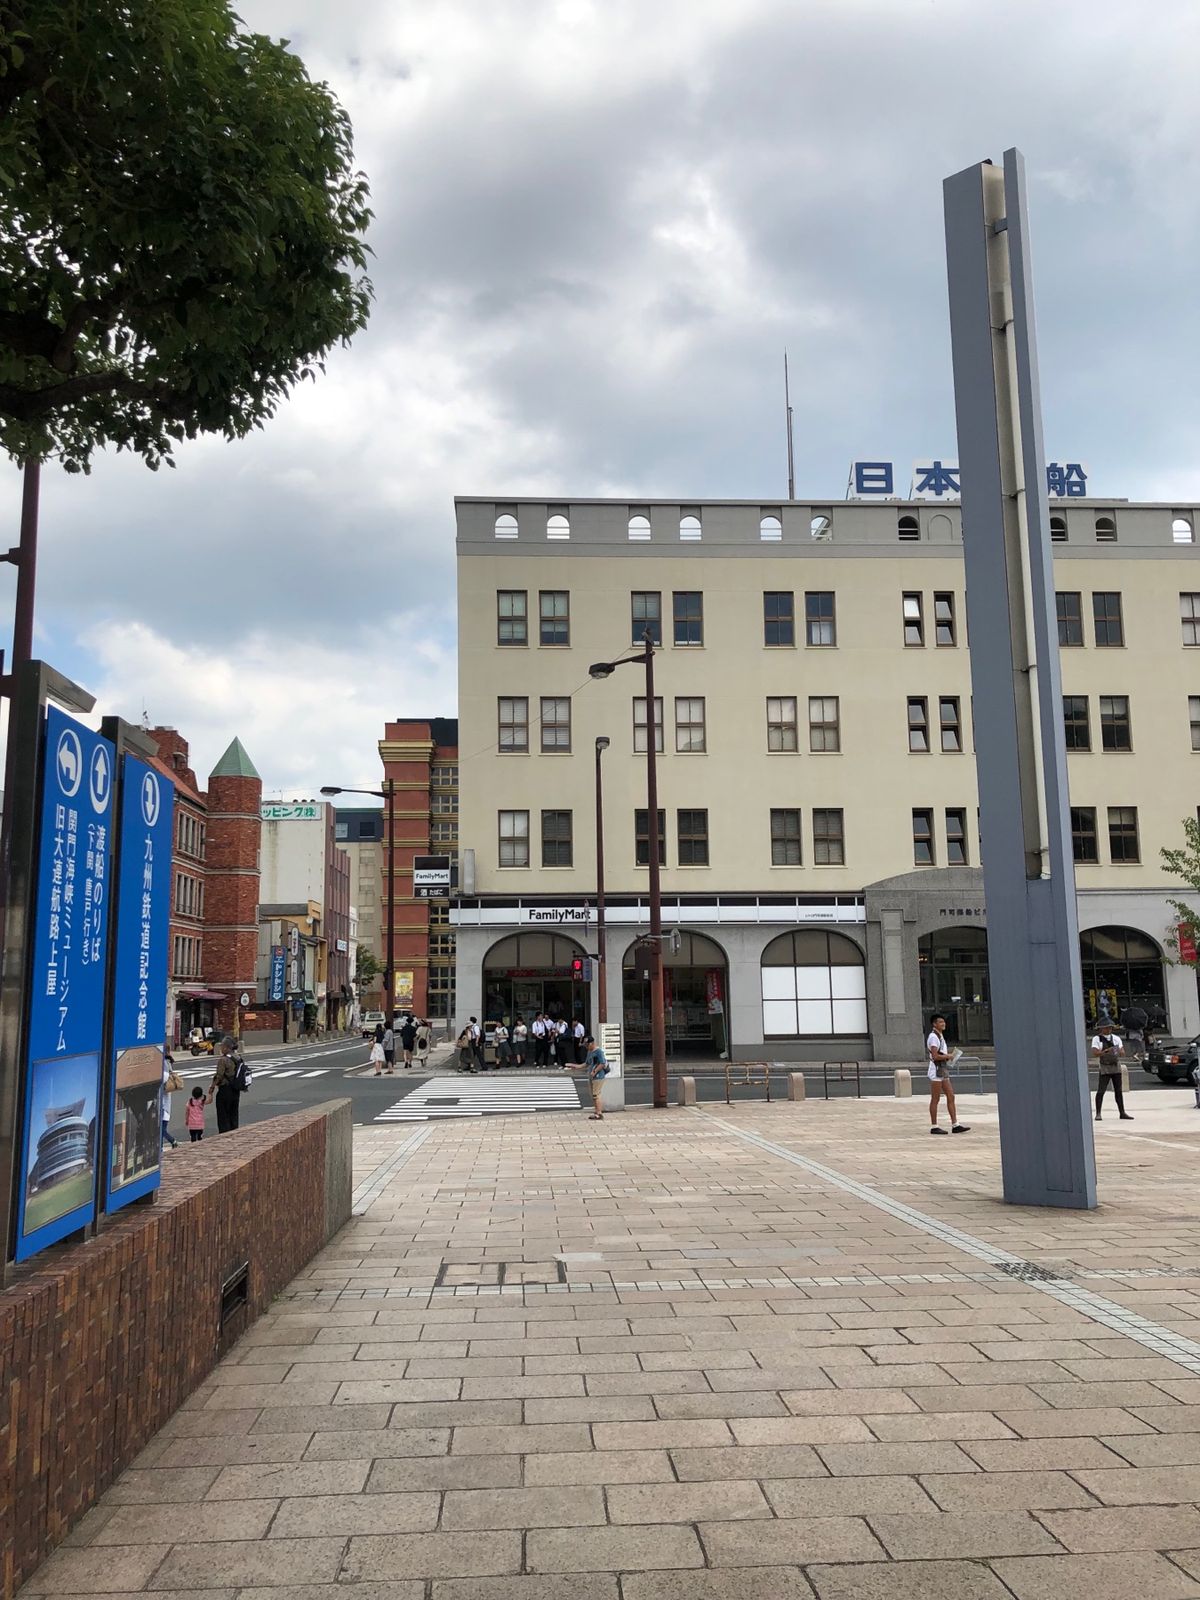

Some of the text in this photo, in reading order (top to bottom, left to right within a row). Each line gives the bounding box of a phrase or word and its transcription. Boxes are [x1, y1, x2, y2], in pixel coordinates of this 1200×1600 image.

[855, 461, 1087, 497] 日本船
[46, 803, 66, 996] 旧大連航路上屋
[56, 808, 78, 1051] 関門海峡ミュージアム
[91, 824, 106, 962] 渡船のりば
[137, 834, 153, 1039] 九州鉄道記念館
[529, 909, 591, 922] FamilyMart
